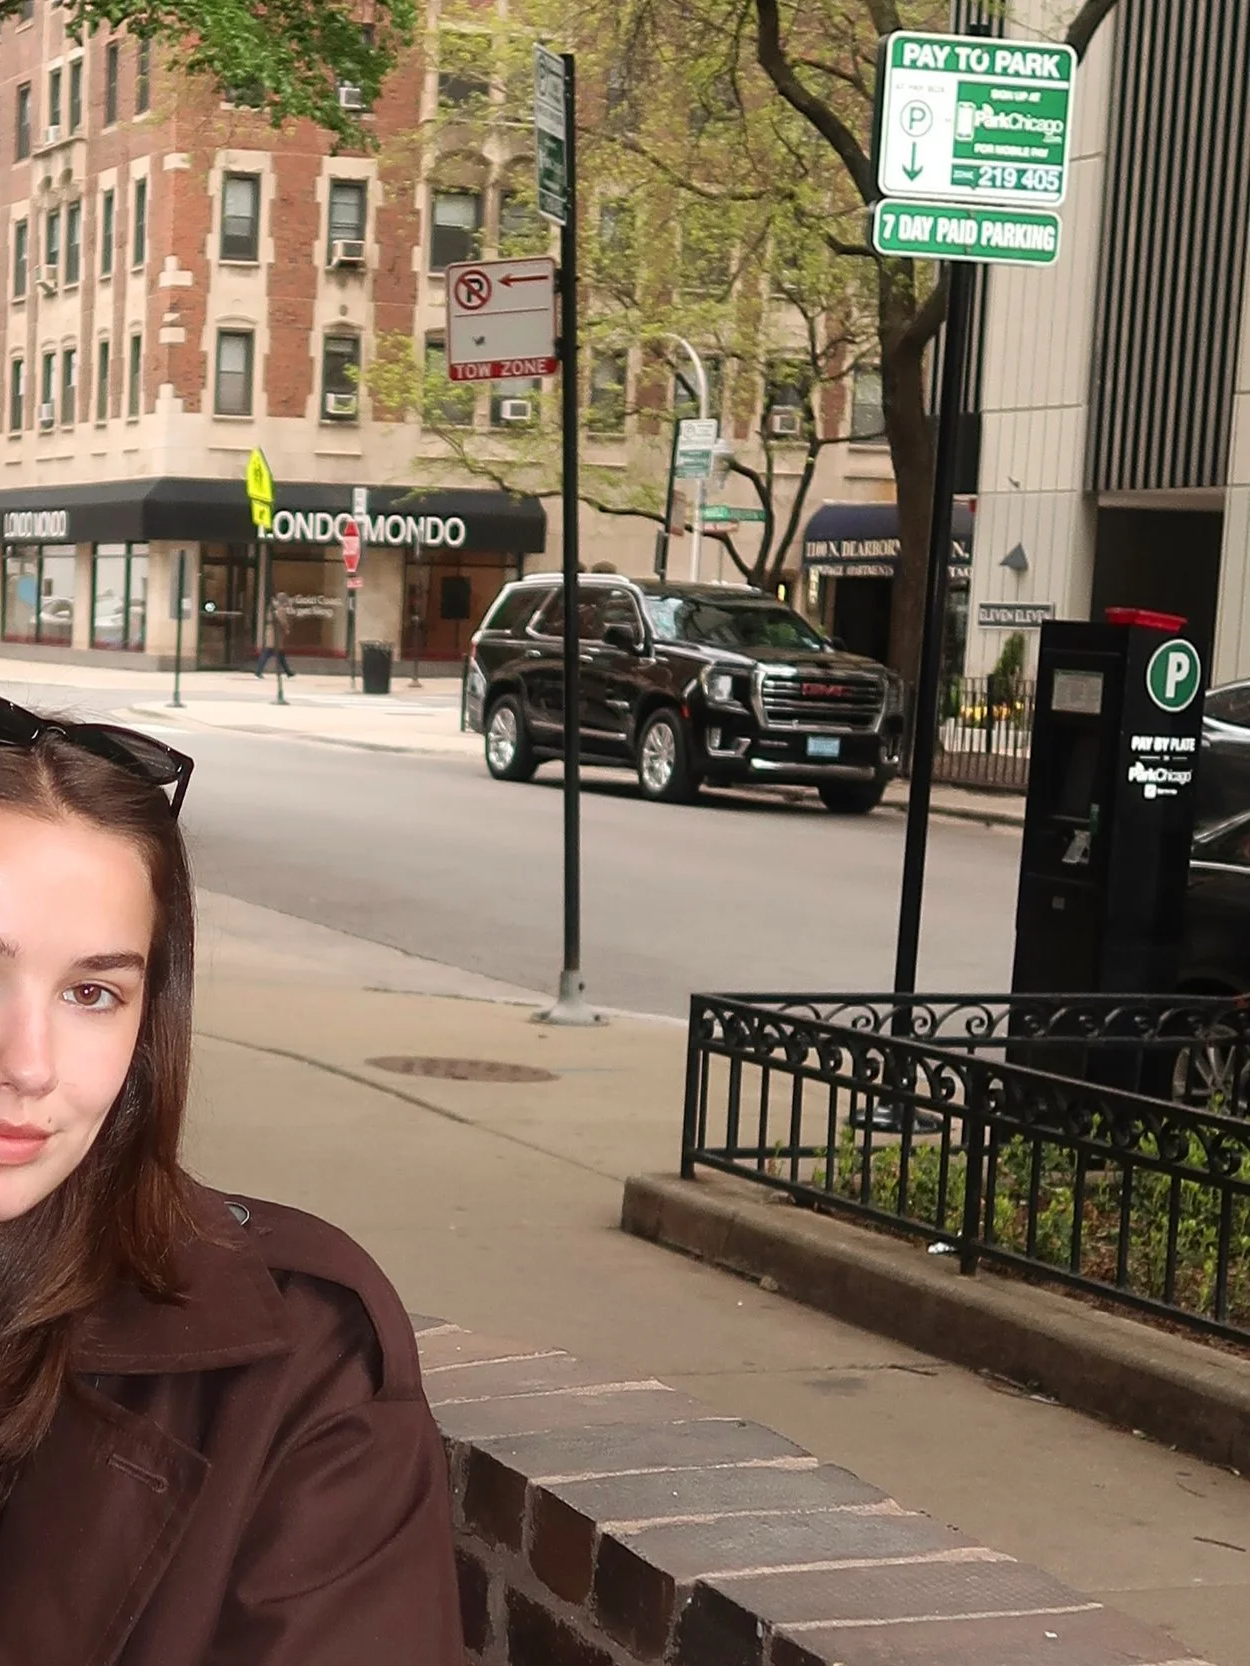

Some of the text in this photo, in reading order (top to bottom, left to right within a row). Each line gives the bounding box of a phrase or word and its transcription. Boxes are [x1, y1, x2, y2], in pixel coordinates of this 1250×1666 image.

[903, 43, 1061, 78] PAY TO PARK
[974, 107, 1064, 135] ParkChicago
[978, 166, 1018, 187] 219
[1021, 168, 1060, 191] 405
[882, 214, 1056, 251] 7 DAY PAID PARKING
[454, 359, 547, 379] TOW ZONE
[361, 514, 466, 548] MONDO
[1164, 652, 1191, 699] P
[1131, 735, 1196, 752] PAY BY PLATE
[1128, 764, 1192, 786] ParkChicago
